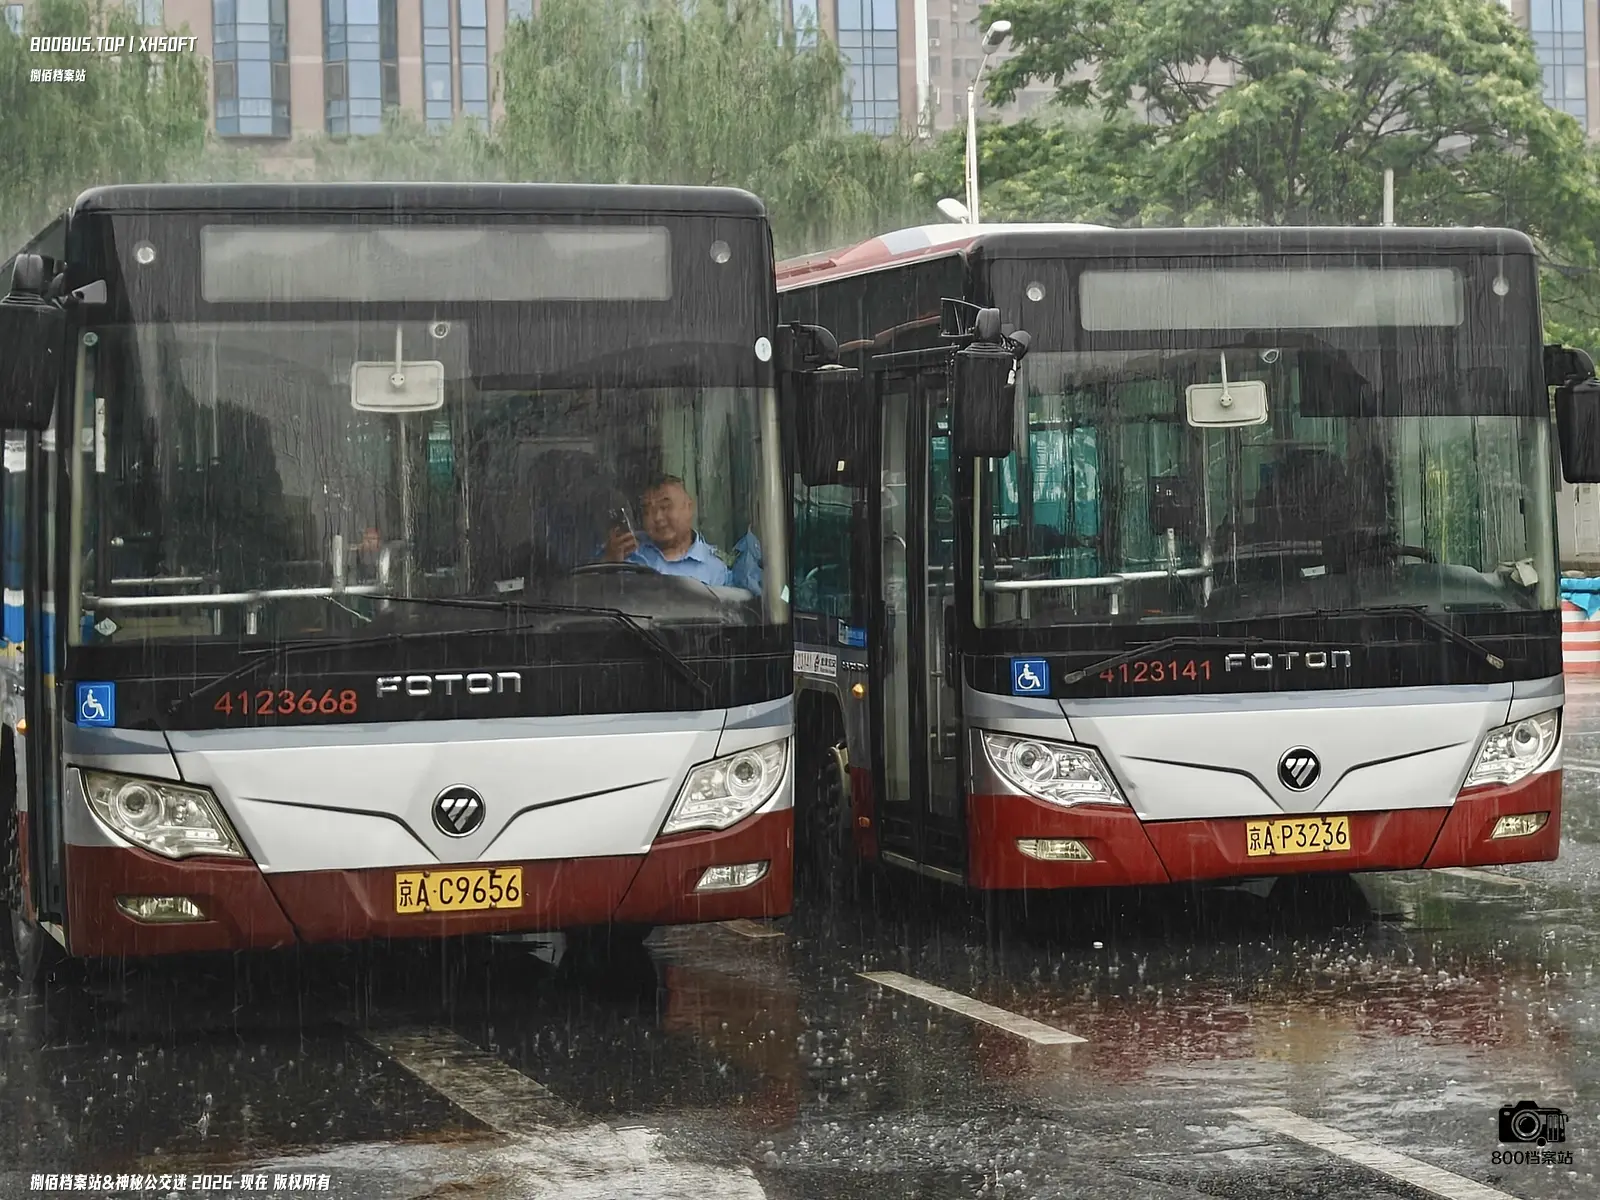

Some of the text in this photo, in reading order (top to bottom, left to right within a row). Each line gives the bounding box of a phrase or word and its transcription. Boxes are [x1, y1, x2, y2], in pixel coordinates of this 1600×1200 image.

[1100, 660, 1212, 683] 4123141
[1225, 650, 1351, 672] FOTON
[376, 671, 522, 698] FOTON
[214, 689, 358, 715] 4123668
[1249, 821, 1347, 850] 京A·P3236
[398, 874, 520, 907] 京A·C9656
